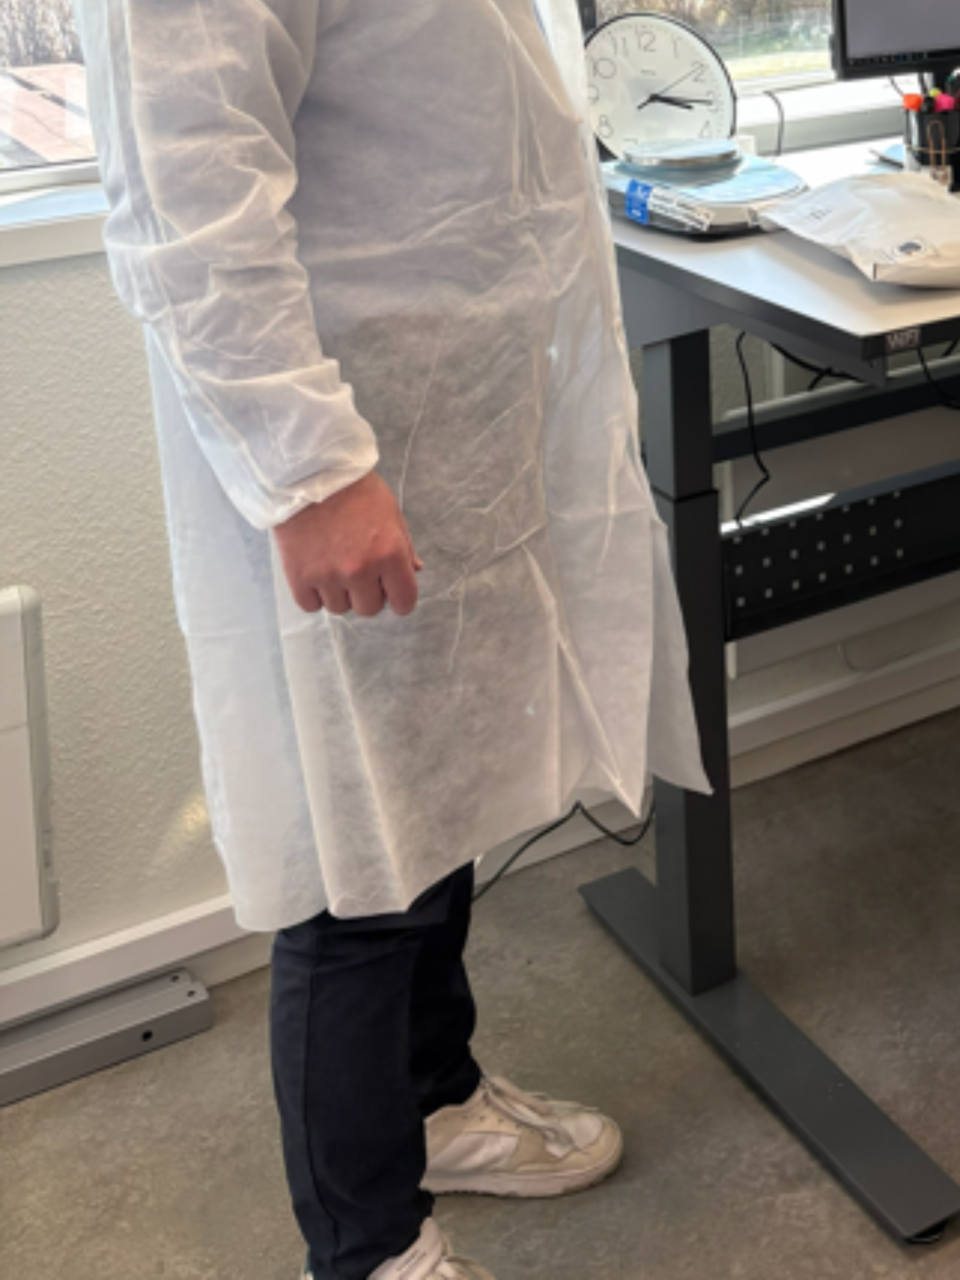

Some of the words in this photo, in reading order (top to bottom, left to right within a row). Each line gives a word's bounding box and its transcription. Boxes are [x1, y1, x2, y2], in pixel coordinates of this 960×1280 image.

[612, 37, 629, 58] 11
[637, 29, 656, 52] 12
[592, 58, 617, 79] 10
[691, 61, 706, 82] 2
[706, 90, 718, 113] 3
[598, 114, 614, 138] 8
